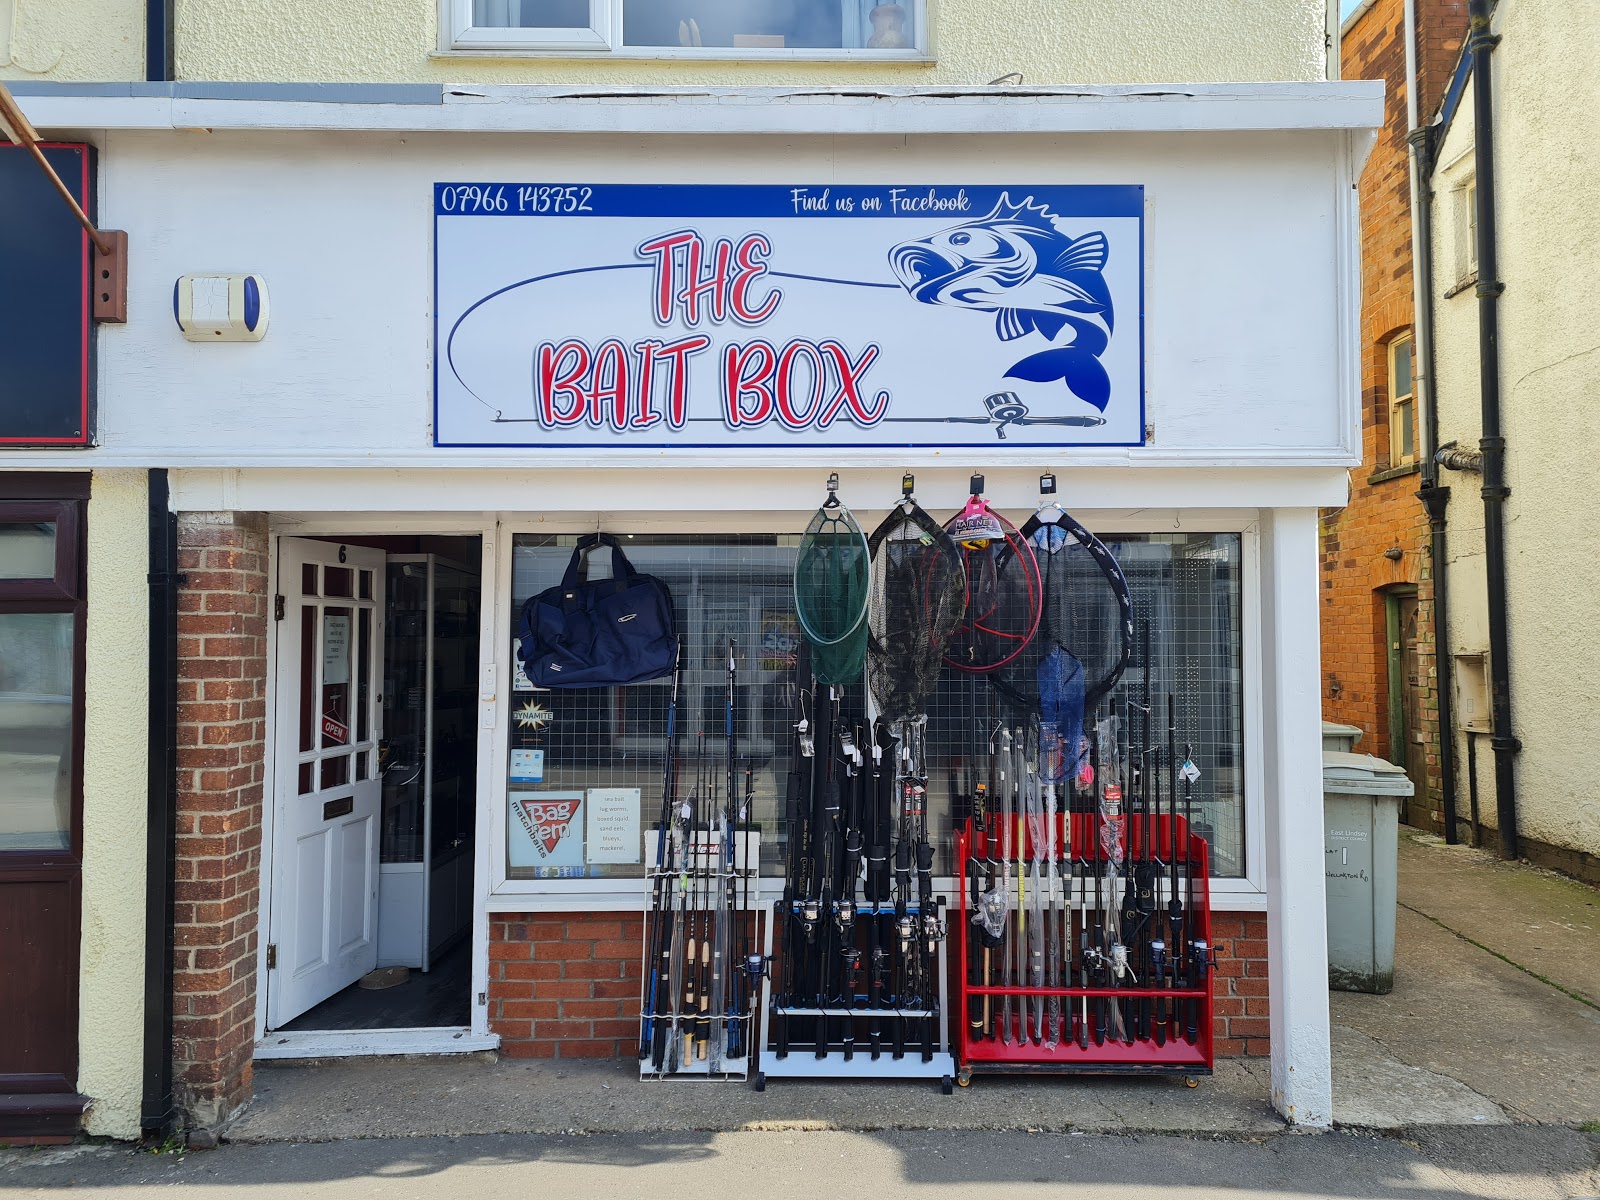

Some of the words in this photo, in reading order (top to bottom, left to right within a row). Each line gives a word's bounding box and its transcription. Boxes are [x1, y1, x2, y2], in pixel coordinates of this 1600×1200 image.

[441, 186, 509, 212] 07966
[516, 186, 593, 212] 143752
[790, 187, 830, 214] Find
[835, 194, 856, 212] us
[861, 196, 882, 211] on
[888, 187, 971, 214] Facebook
[637, 228, 784, 326] THE
[536, 335, 712, 431] BAIT
[722, 336, 891, 431] BOX
[513, 712, 553, 720] DYNAMITE
[325, 722, 343, 738] OPEN
[525, 801, 571, 825] Bag
[511, 801, 547, 859] matchbaits
